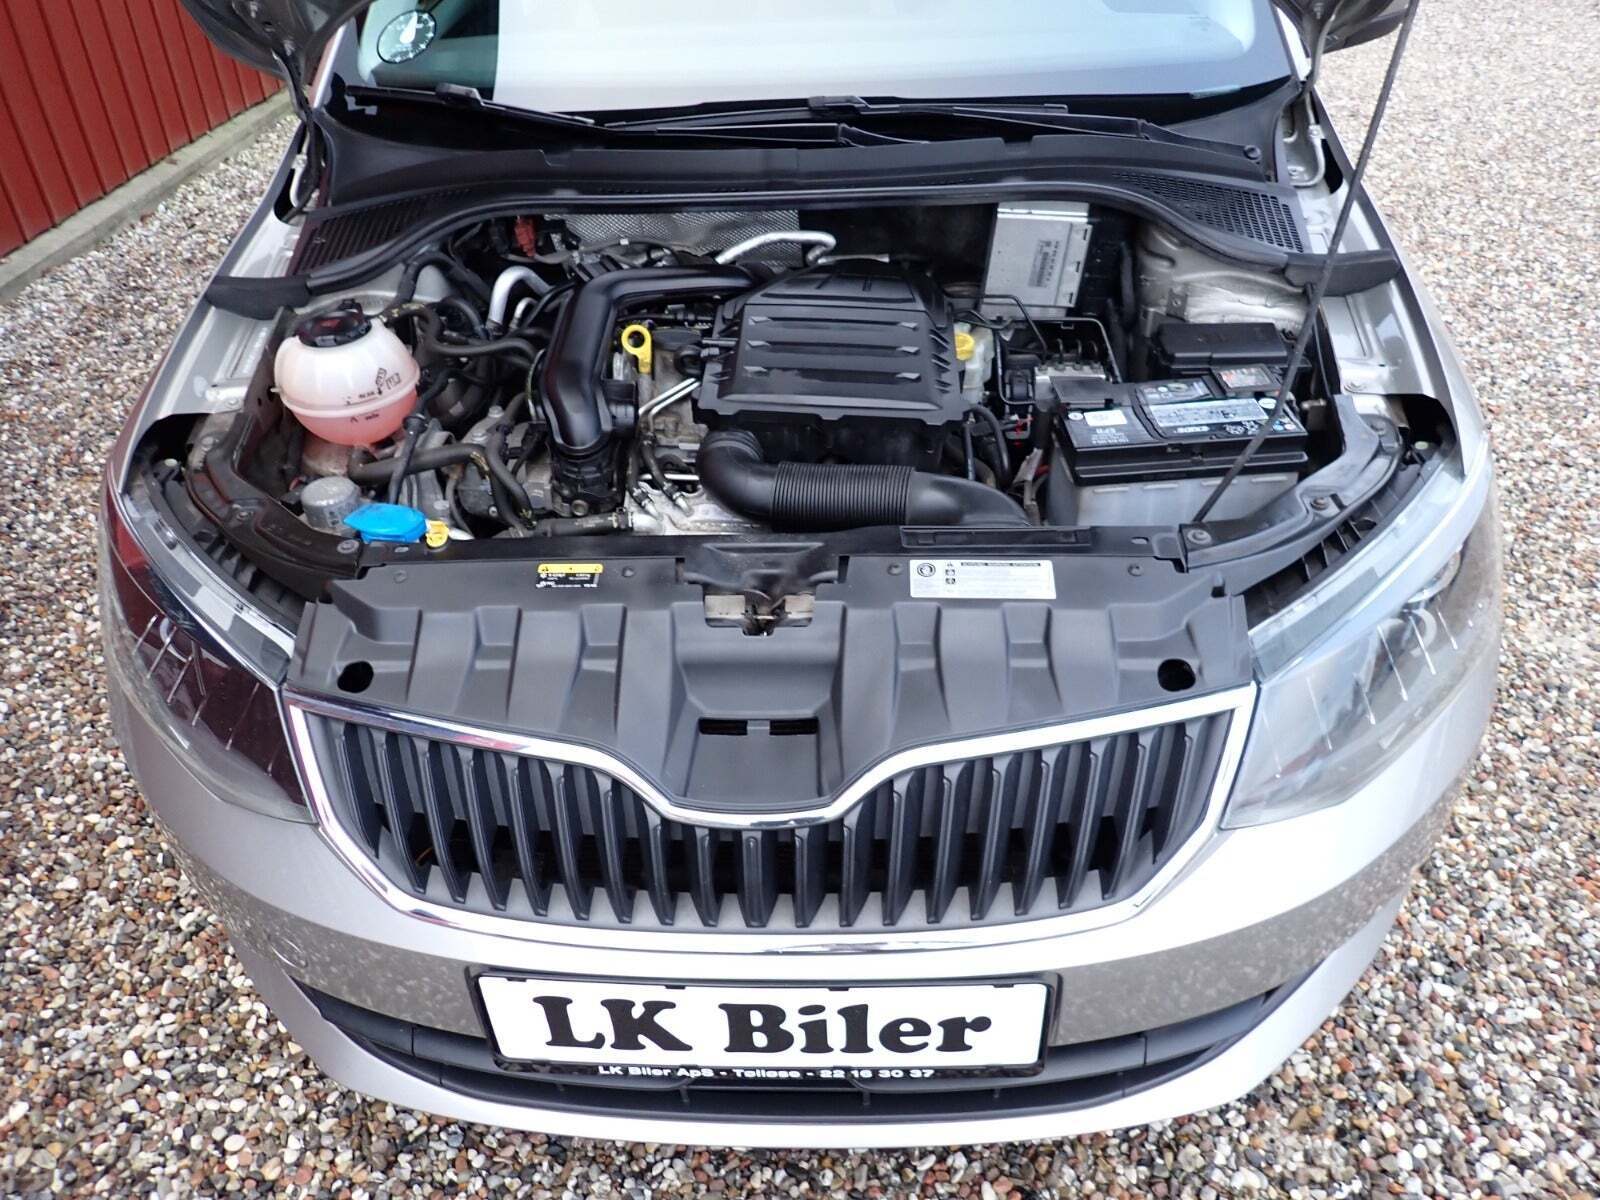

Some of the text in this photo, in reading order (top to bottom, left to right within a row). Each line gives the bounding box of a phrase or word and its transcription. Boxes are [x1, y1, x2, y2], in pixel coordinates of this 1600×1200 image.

[532, 996, 992, 1054] LK Biler
[598, 1065, 624, 1076] LK
[628, 1066, 672, 1077] Biler
[677, 1068, 715, 1079] ApS
[819, 1069, 846, 1079] 22
[878, 1069, 904, 1079] 30
[909, 1069, 935, 1079] 37
